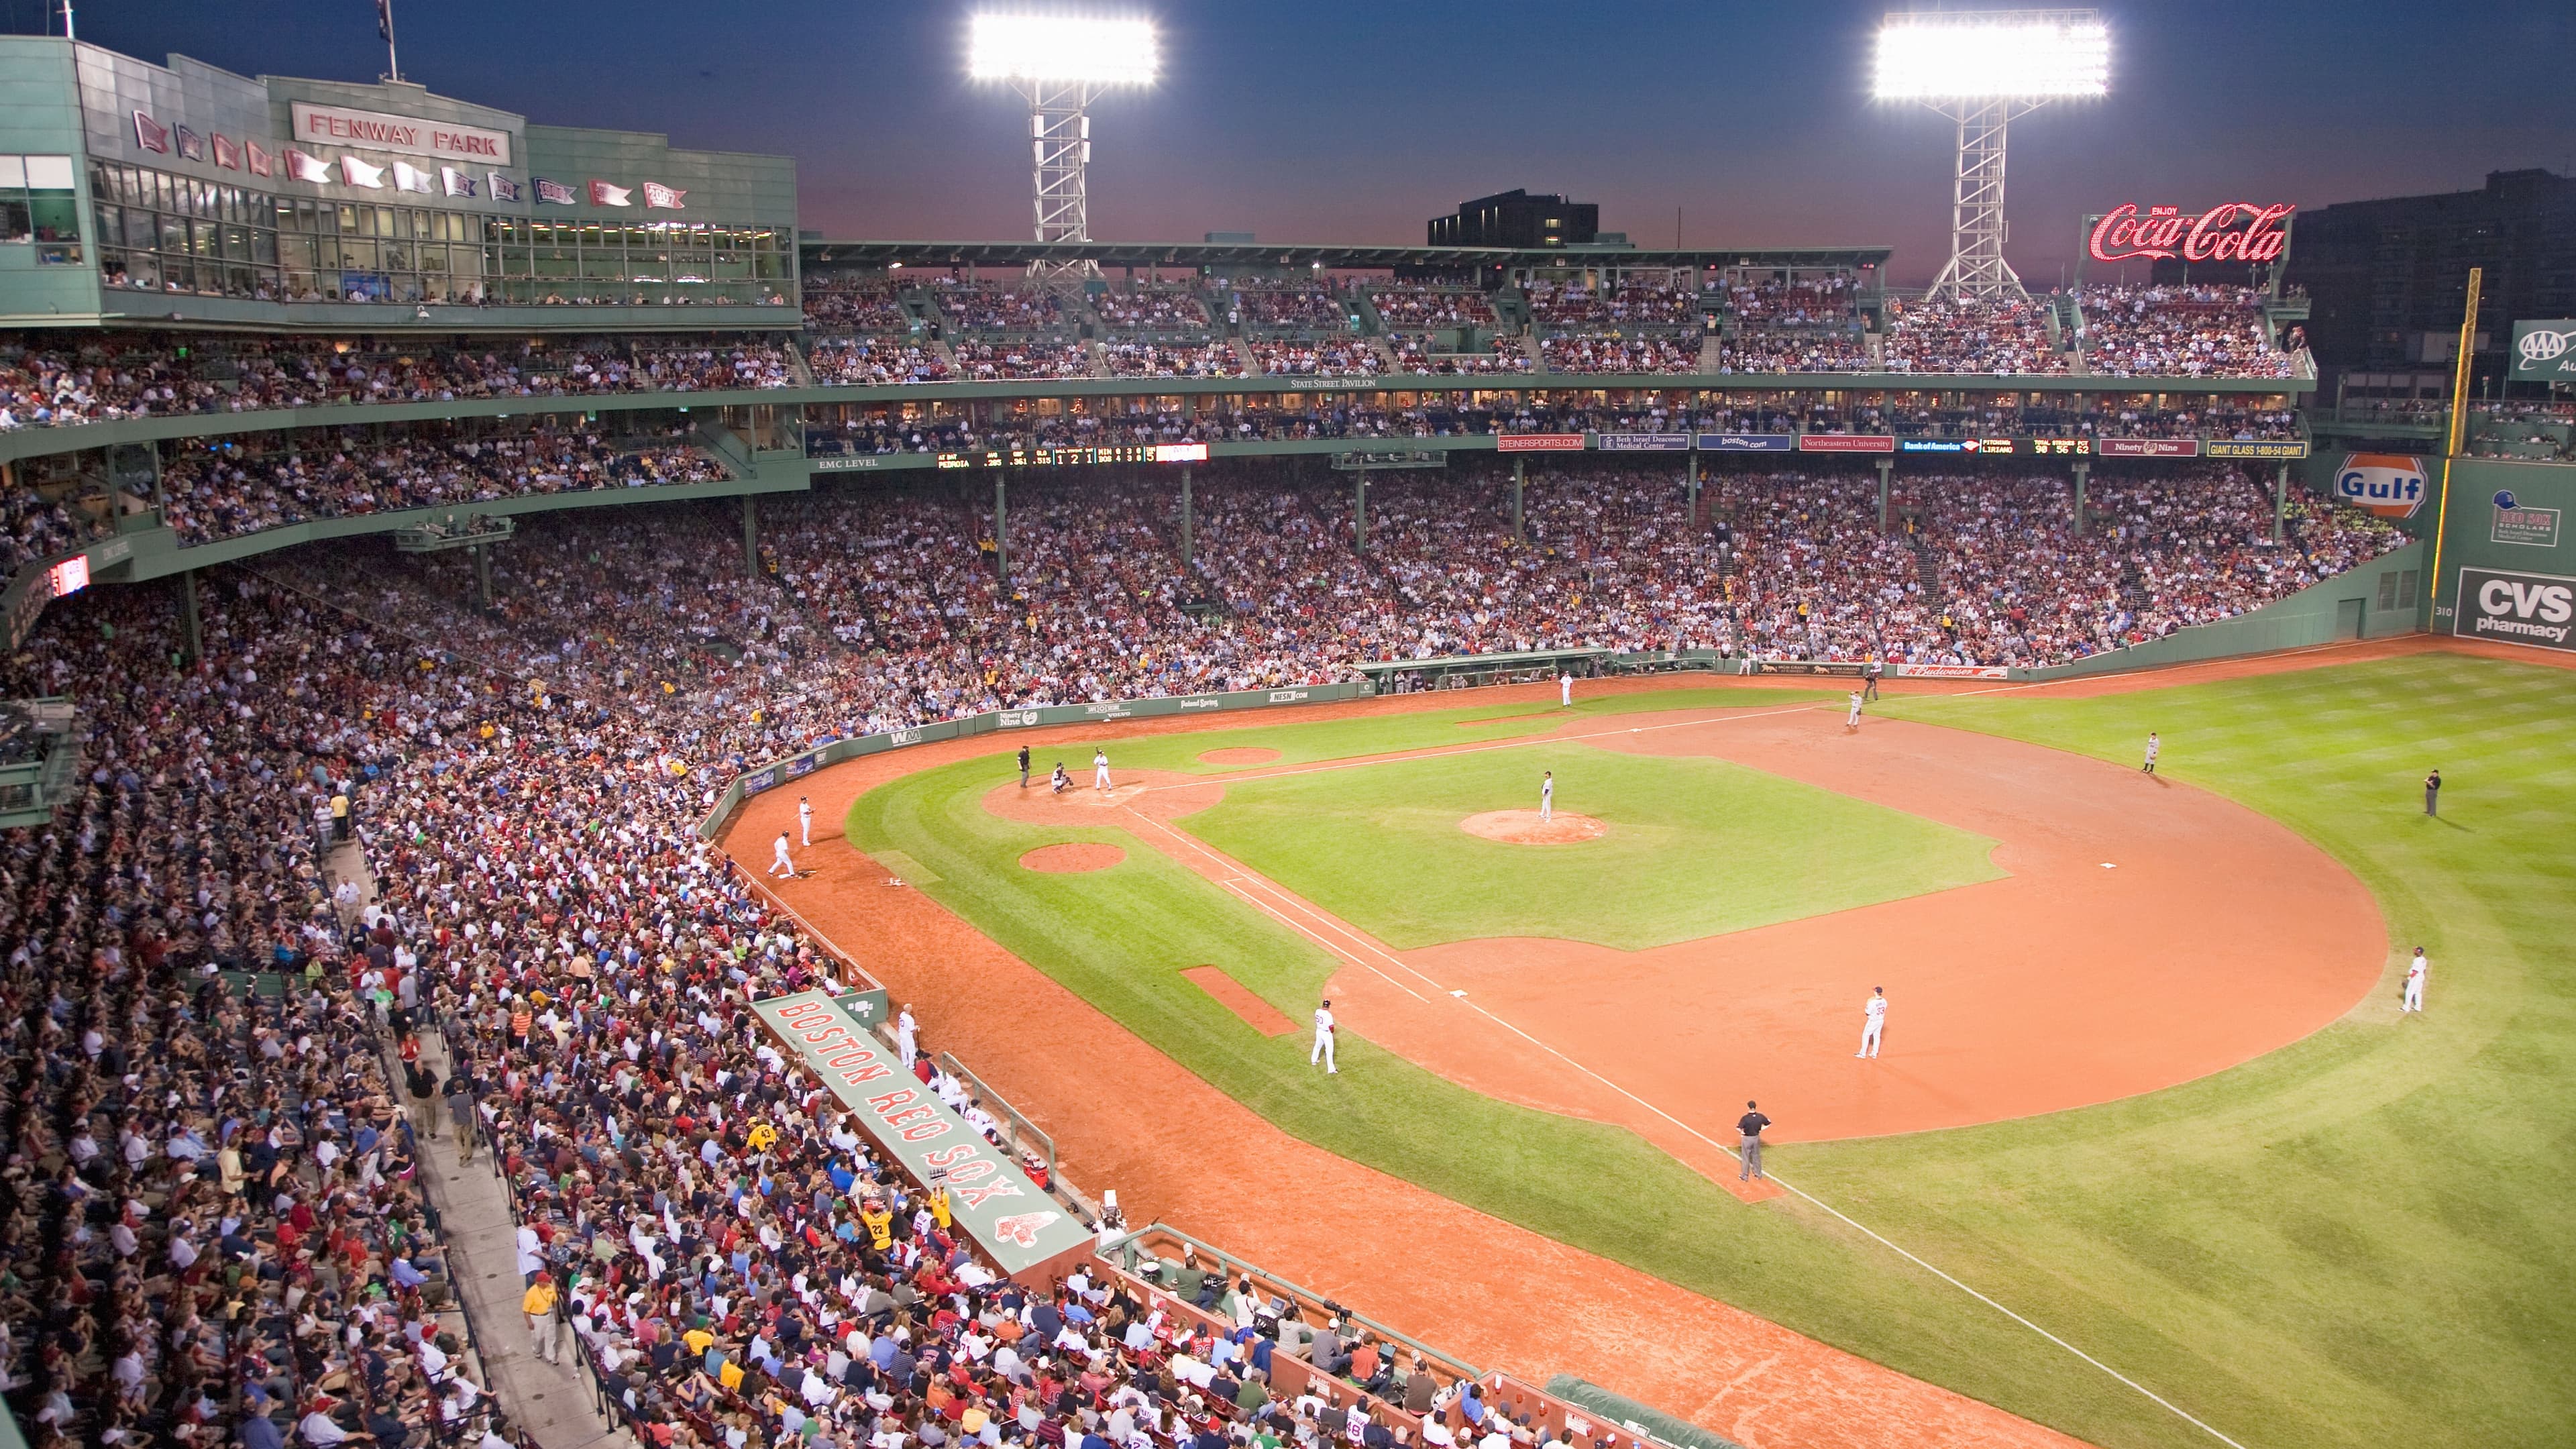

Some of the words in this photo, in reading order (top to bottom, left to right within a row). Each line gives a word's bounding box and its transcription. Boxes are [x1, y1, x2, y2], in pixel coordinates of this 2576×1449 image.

[310, 113, 419, 146] FENWAY
[435, 131, 498, 156] PARK
[649, 188, 676, 204] 2007
[2152, 207, 2178, 215] ENJOY
[2523, 332, 2561, 359] AAA
[1291, 380, 1312, 388] STATE
[1313, 380, 1340, 388] STREET
[1342, 379, 1375, 387] PAVILION
[1499, 438, 1582, 448] STEINERSPORTS.COM
[1805, 439, 1851, 447] Northeastern
[1853, 439, 1890, 449] University
[2115, 443, 2142, 452] Ninety
[2158, 443, 2178, 451] Nine
[2210, 445, 2230, 454] GIANT
[2233, 445, 2254, 454] GLASS
[2282, 445, 2302, 455] GIANT
[1057, 455, 1063, 464] 1
[1071, 454, 1079, 464] 2
[1087, 454, 1093, 463] 1
[1146, 452, 1155, 462] 5
[819, 461, 843, 469] EMC
[845, 459, 878, 468] LEVEL
[938, 460, 969, 469] PEDROIA
[2341, 472, 2420, 500] Gulf
[2500, 511, 2525, 523] RED
[2527, 513, 2552, 525] SOX
[2499, 523, 2551, 531] SCHOLARS
[2479, 579, 2573, 623] CVS
[2435, 606, 2453, 616] 310
[2475, 616, 2569, 643] pharmacy
[1914, 666, 1973, 676] Budweiser
[1181, 699, 1199, 708] Poland
[1199, 698, 1218, 708] Spring
[1000, 712, 1022, 720] Ninety
[776, 1000, 894, 1087] BOSTON
[865, 1087, 953, 1143] RED
[966, 1114, 977, 1122] 44
[761, 1128, 771, 1139] 43
[920, 1143, 1026, 1210] SOX
[872, 1225, 883, 1235] 22
